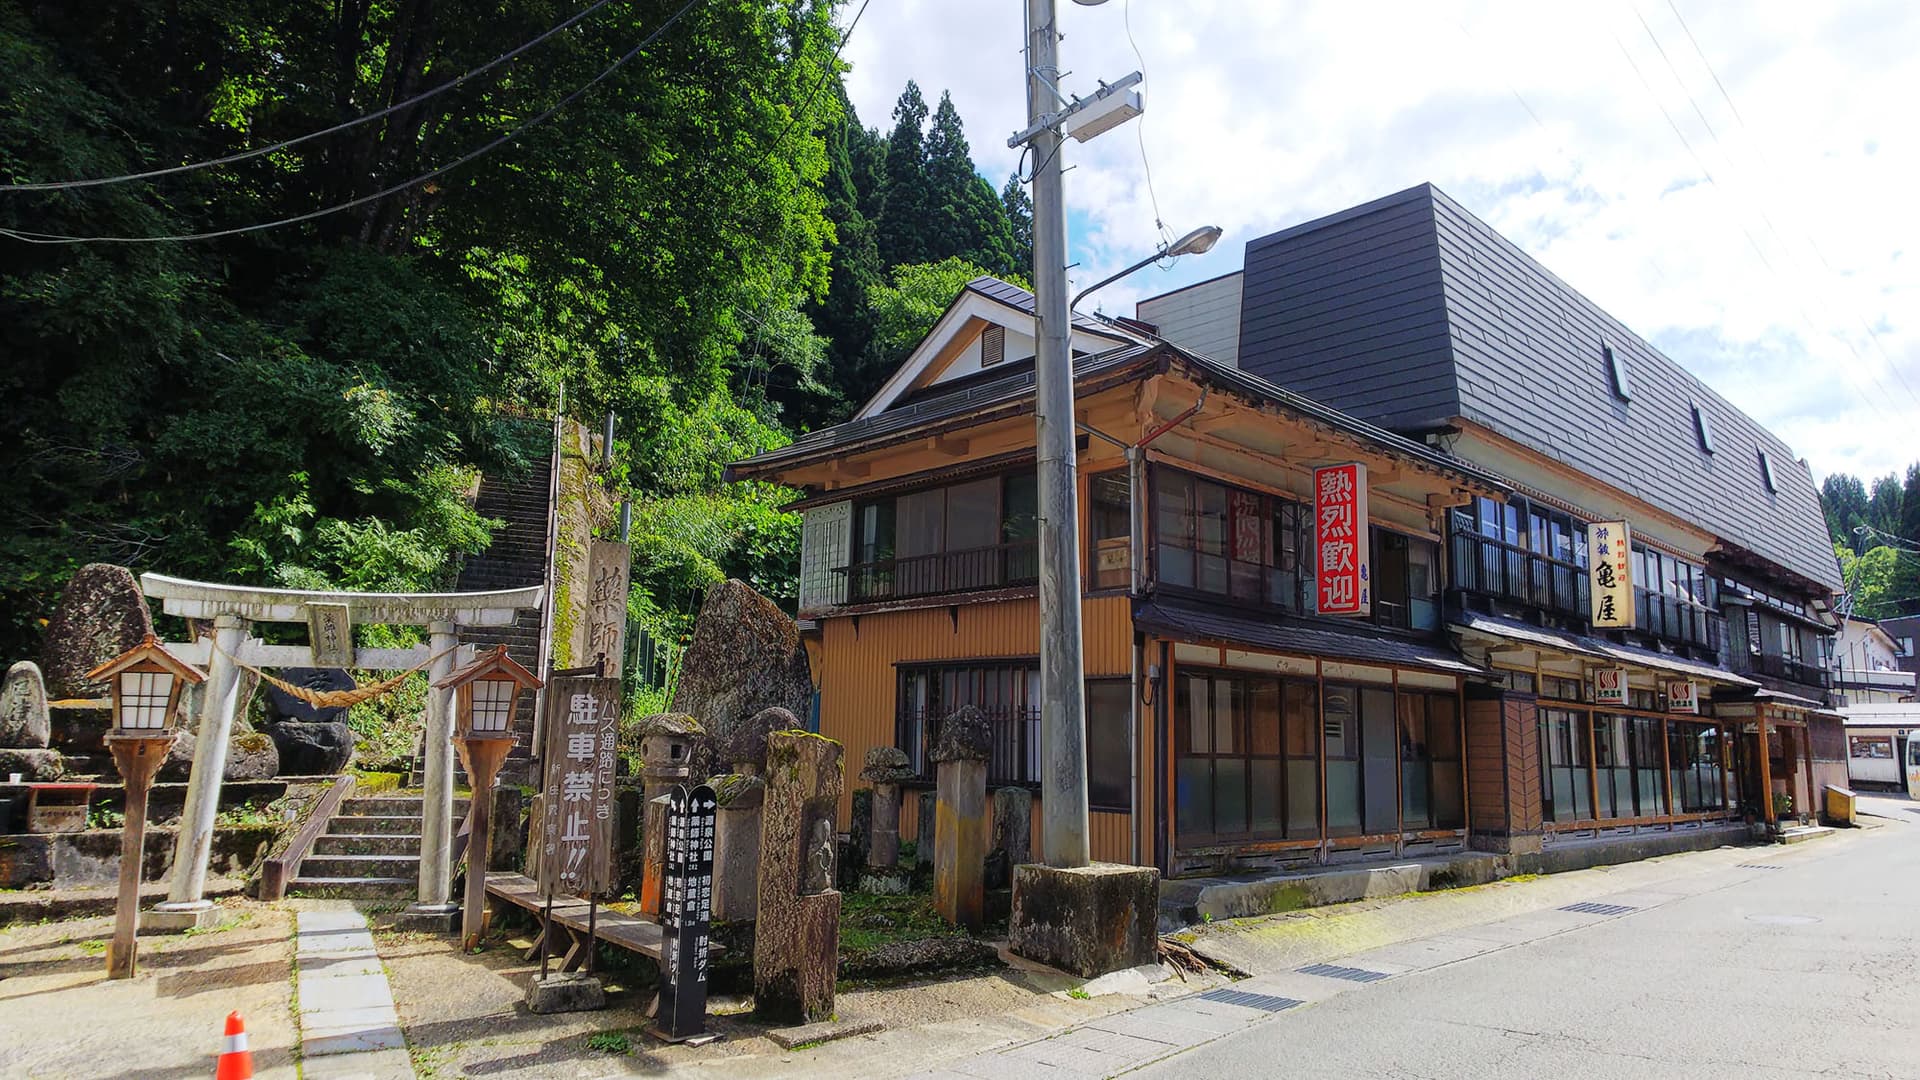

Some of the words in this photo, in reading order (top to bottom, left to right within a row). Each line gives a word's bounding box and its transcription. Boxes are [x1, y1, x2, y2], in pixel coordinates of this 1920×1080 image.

[1320, 470, 1354, 609] 熱烈歓迎
[596, 698, 618, 820] バス通路につき
